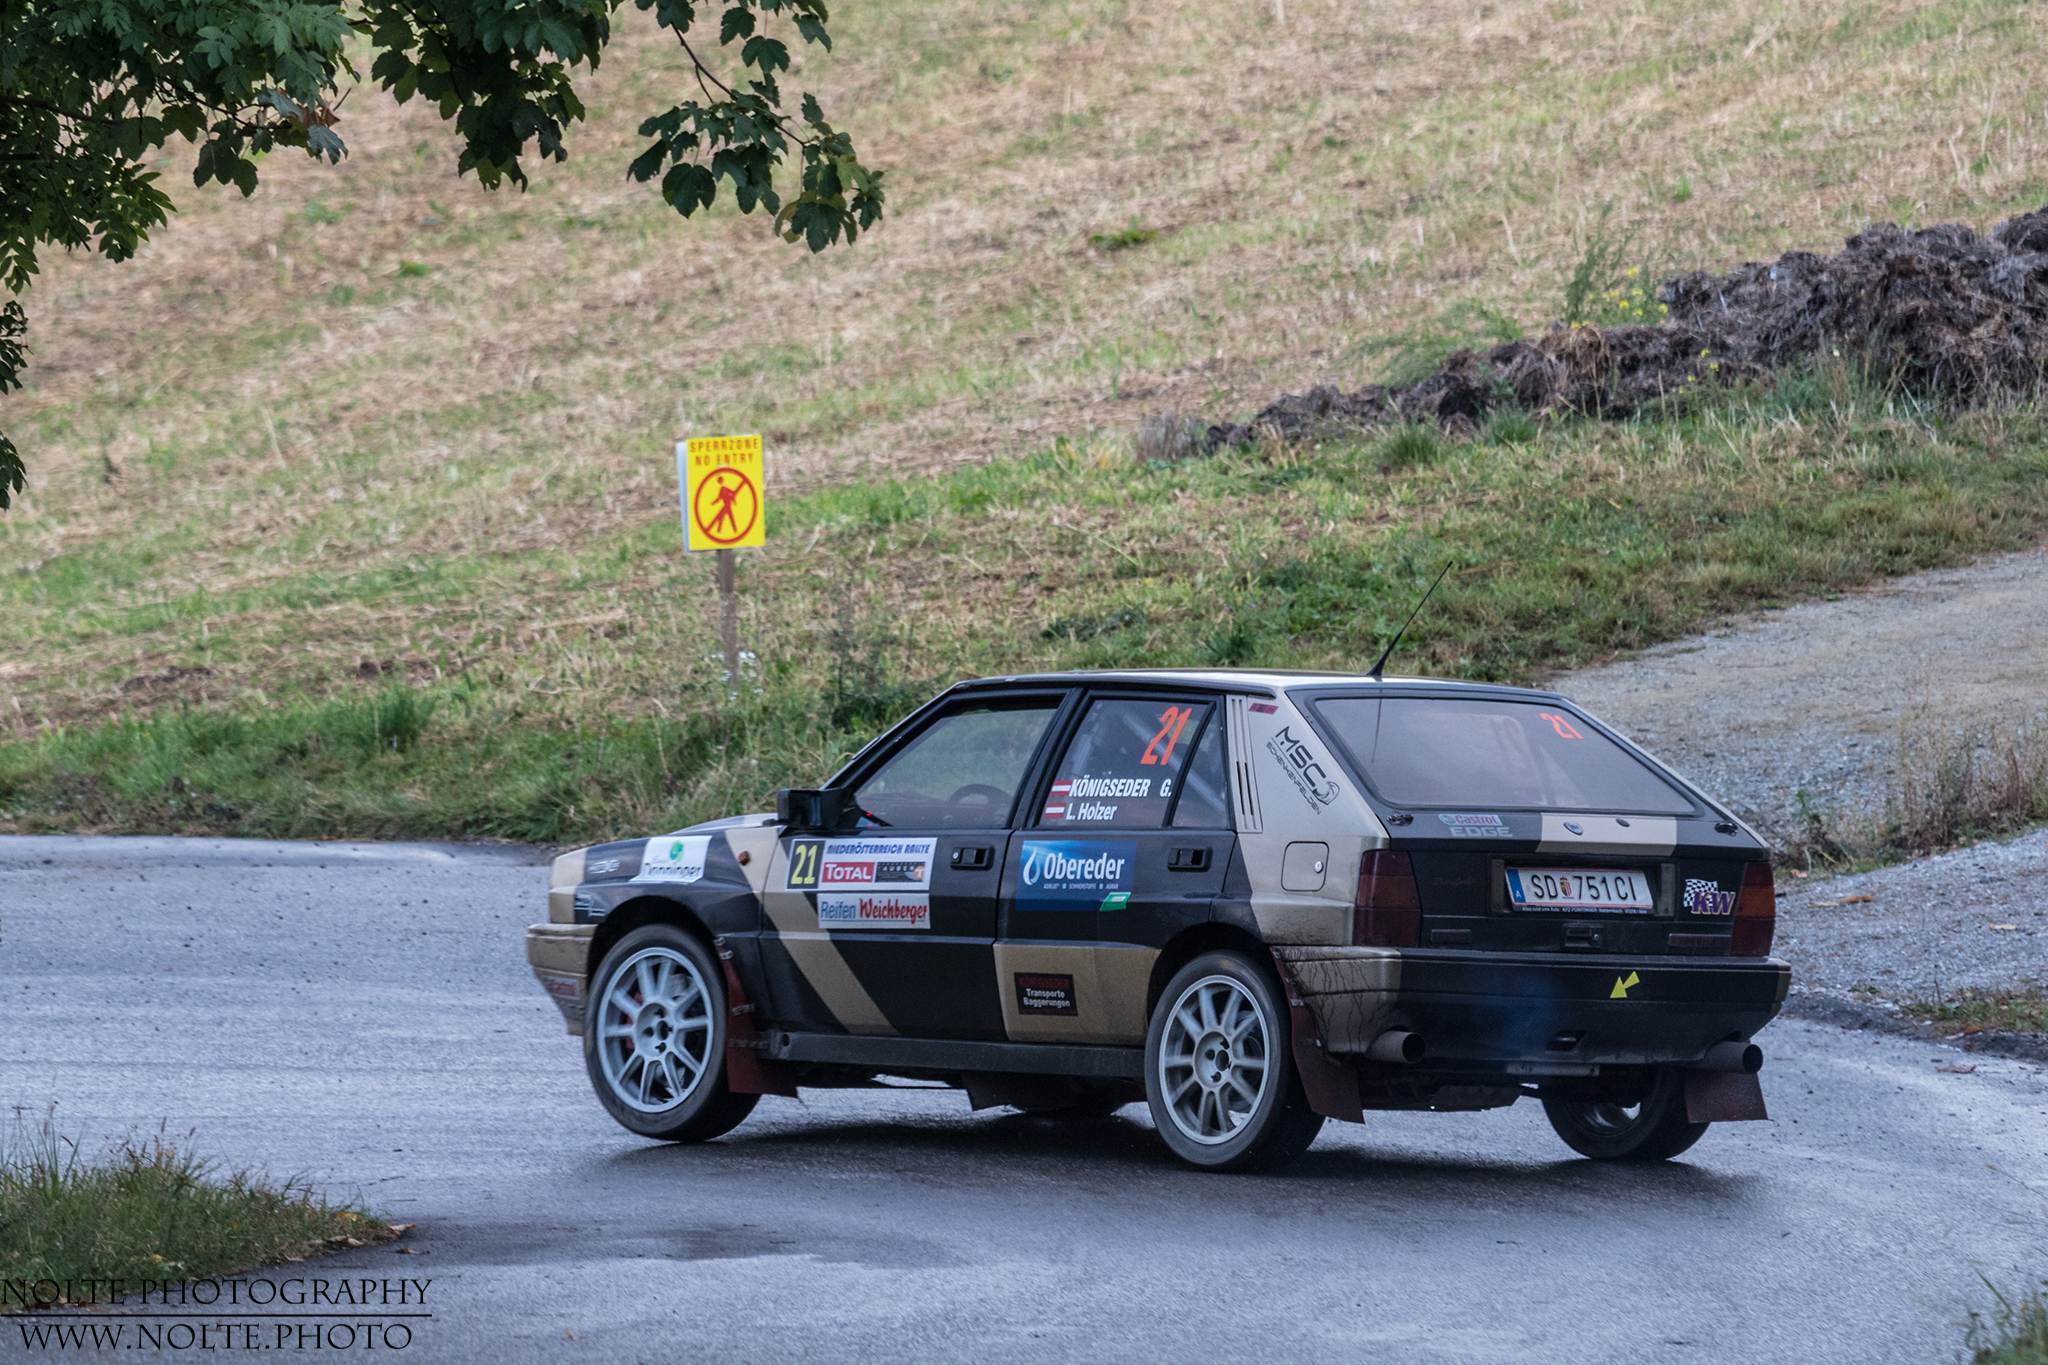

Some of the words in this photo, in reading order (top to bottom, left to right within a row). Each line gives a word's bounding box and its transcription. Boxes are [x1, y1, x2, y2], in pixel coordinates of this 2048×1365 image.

[690, 438, 759, 453] SPERRZONE
[695, 455, 711, 467] NO
[716, 452, 754, 466] ENTRY
[1140, 706, 1193, 765] 21
[1540, 713, 1583, 739] 21
[1275, 726, 1327, 788] MSC
[1069, 774, 1151, 798] KÖNIGSEDER
[1159, 778, 1172, 798] G.
[1065, 802, 1077, 820] L.
[1078, 801, 1118, 821] Holzer
[1455, 814, 1499, 825] Castrol
[1450, 826, 1513, 837] EDGE
[827, 842, 904, 854] NIEDERÖSTERREICH
[904, 844, 931, 854] RALLYE
[790, 844, 818, 885] 21
[1043, 852, 1125, 880] Obereder
[1515, 890, 1522, 898] A
[1531, 874, 1558, 899] SD
[1572, 875, 1637, 901] 751CI
[821, 901, 856, 919] Reifen
[859, 898, 928, 925] Weichberger
[1691, 891, 1736, 915] KW
[1023, 997, 1071, 1008] Baggerungen
[1025, 988, 1065, 999] Transporte
